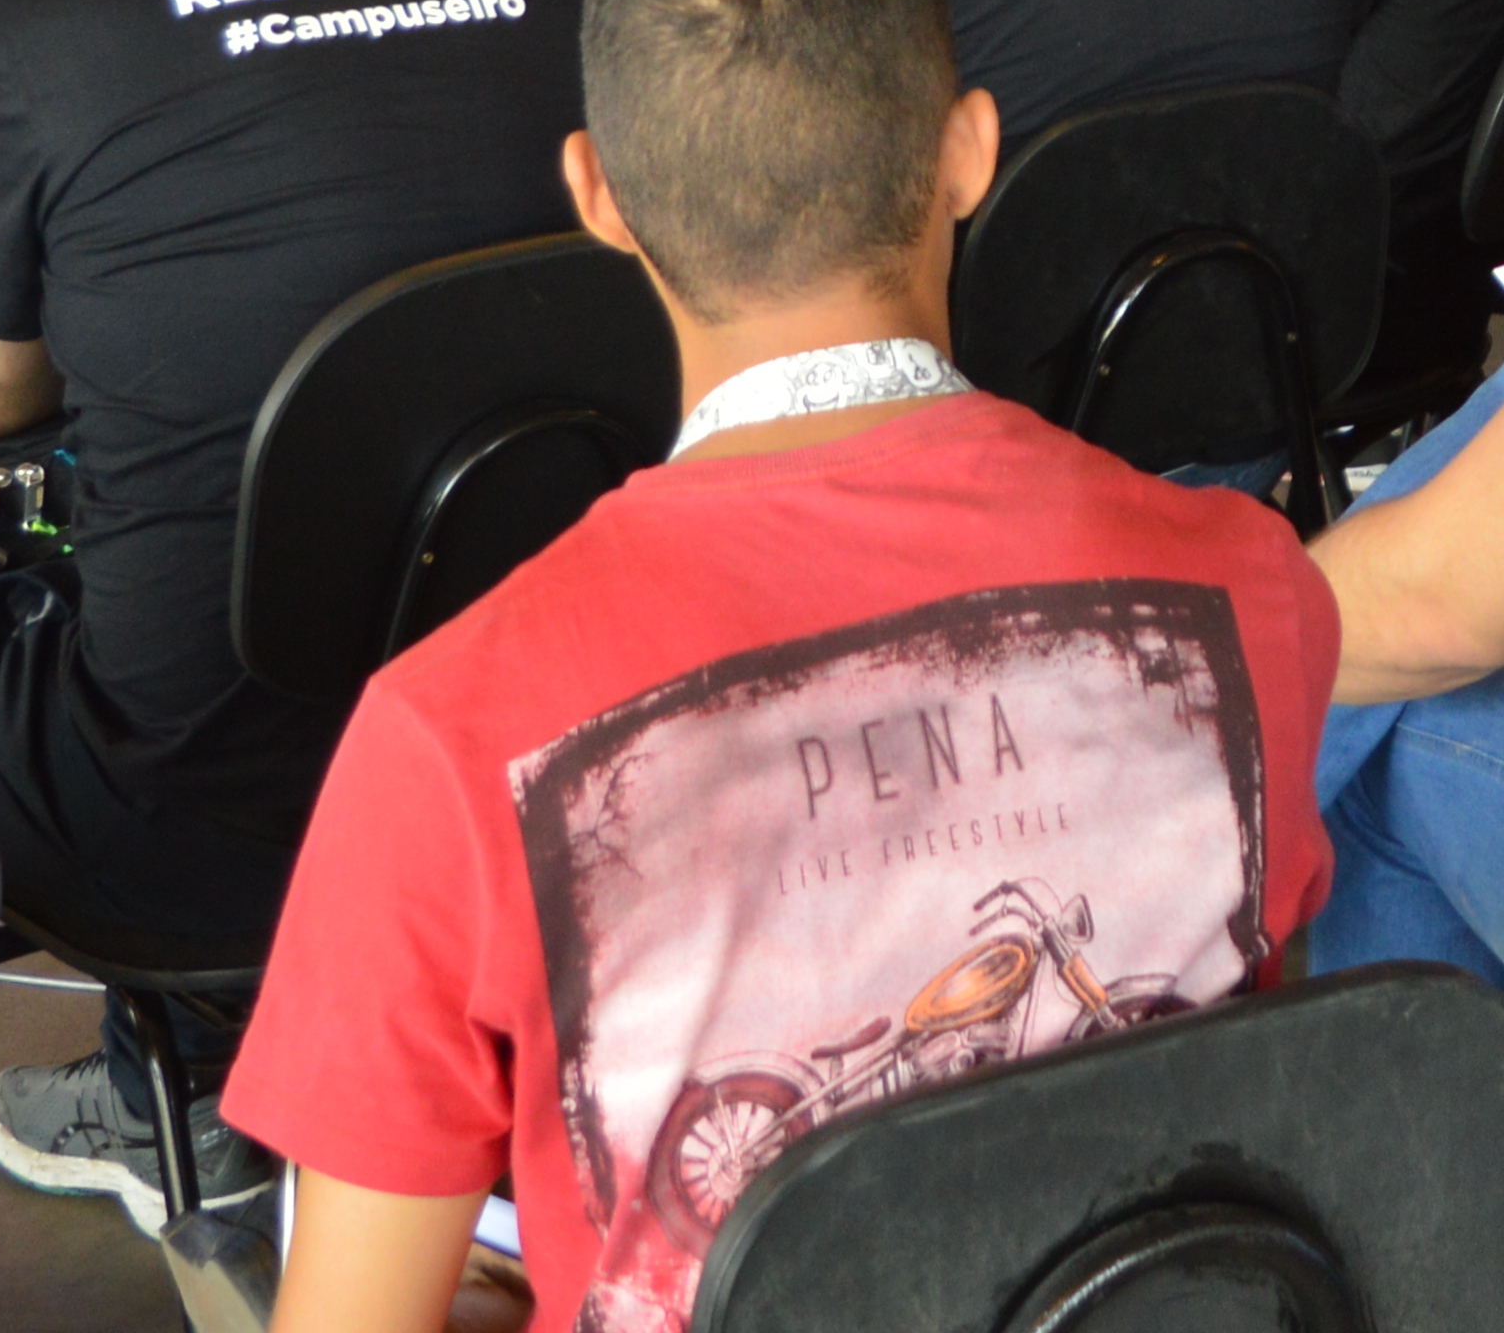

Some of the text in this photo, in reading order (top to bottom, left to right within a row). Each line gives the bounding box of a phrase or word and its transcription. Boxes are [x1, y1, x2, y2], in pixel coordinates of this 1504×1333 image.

[795, 690, 1026, 821] PENA
[778, 801, 1070, 896] LIVE FREESTYLE
